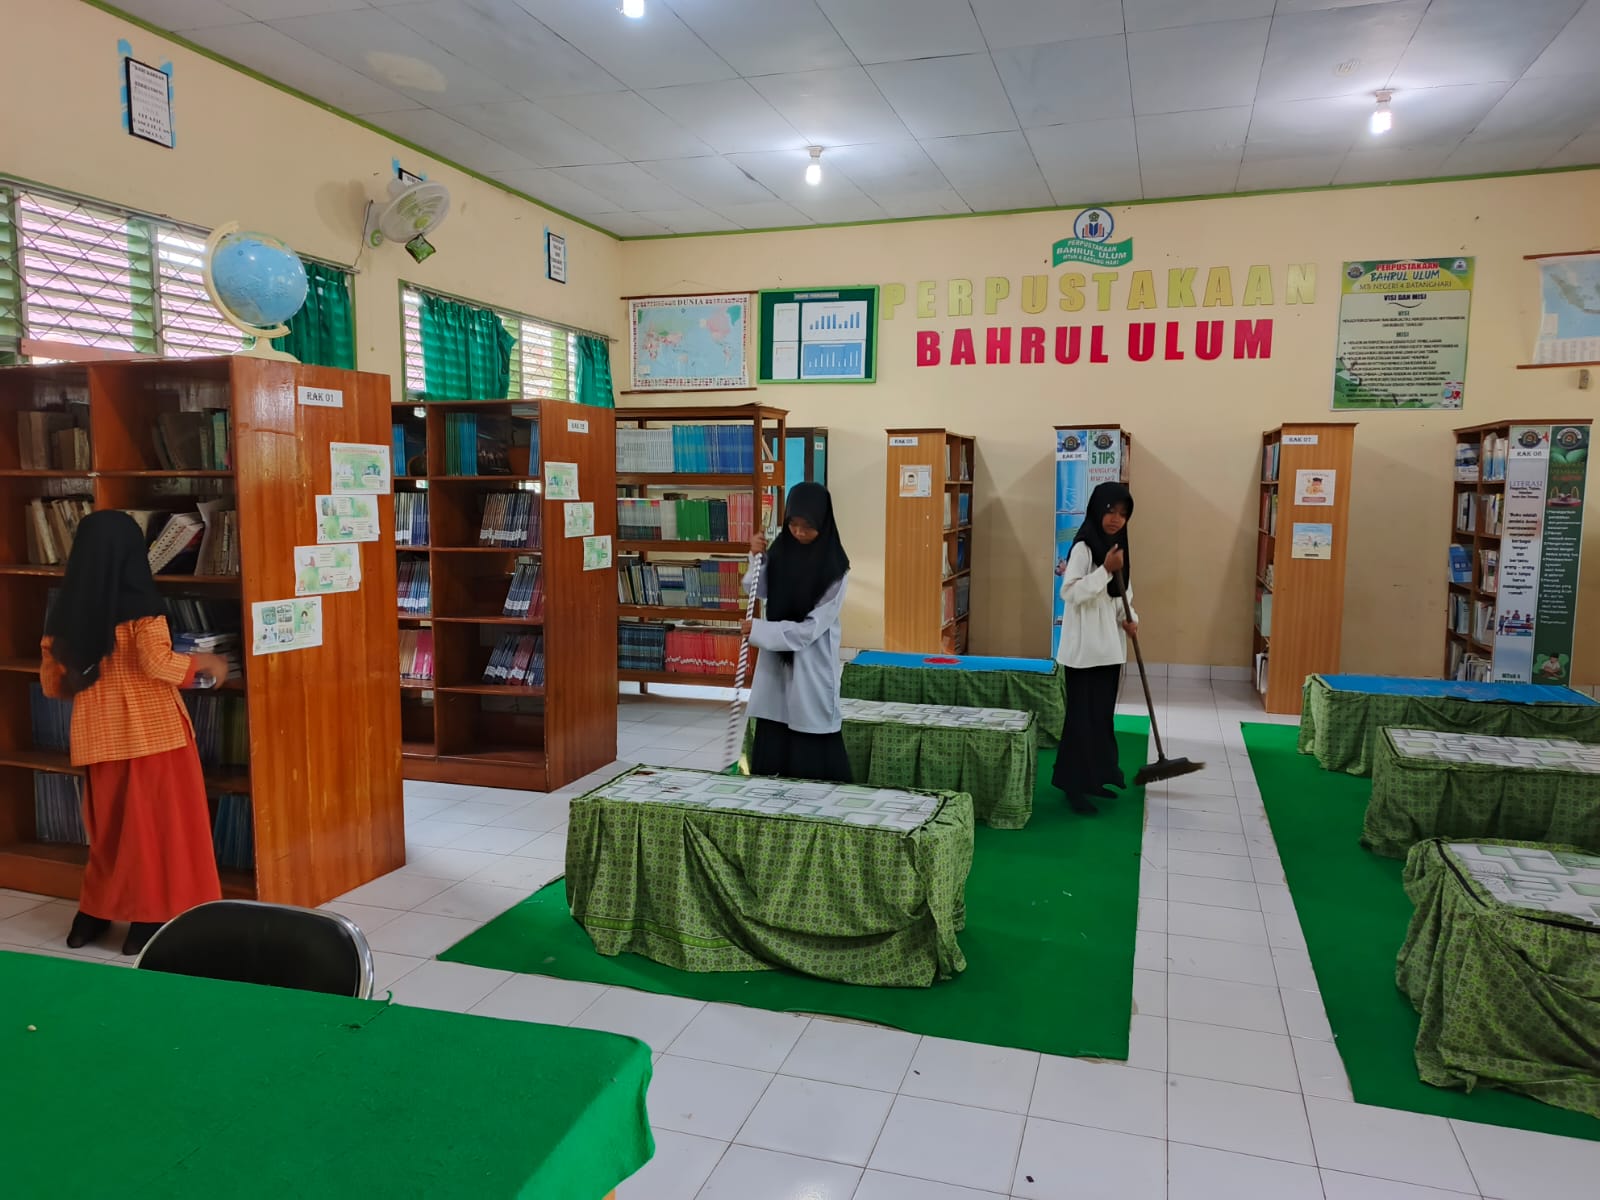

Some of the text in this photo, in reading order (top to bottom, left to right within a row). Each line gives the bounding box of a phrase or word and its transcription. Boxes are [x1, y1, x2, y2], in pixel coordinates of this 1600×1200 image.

[1067, 240, 1117, 252] PERPUSTAKAAN
[1056, 247, 1127, 260] BAHRUL ULUM
[1376, 262, 1439, 271] PERPUSTAKAAN
[1370, 270, 1440, 281] BAHRUL ULUM
[882, 263, 1316, 320] PERPUSTAKAAN
[916, 319, 1273, 367] BAHRUL ULUM
[306, 392, 334, 402] RAK 01
[1092, 452, 1115, 464] 5 TIPS
